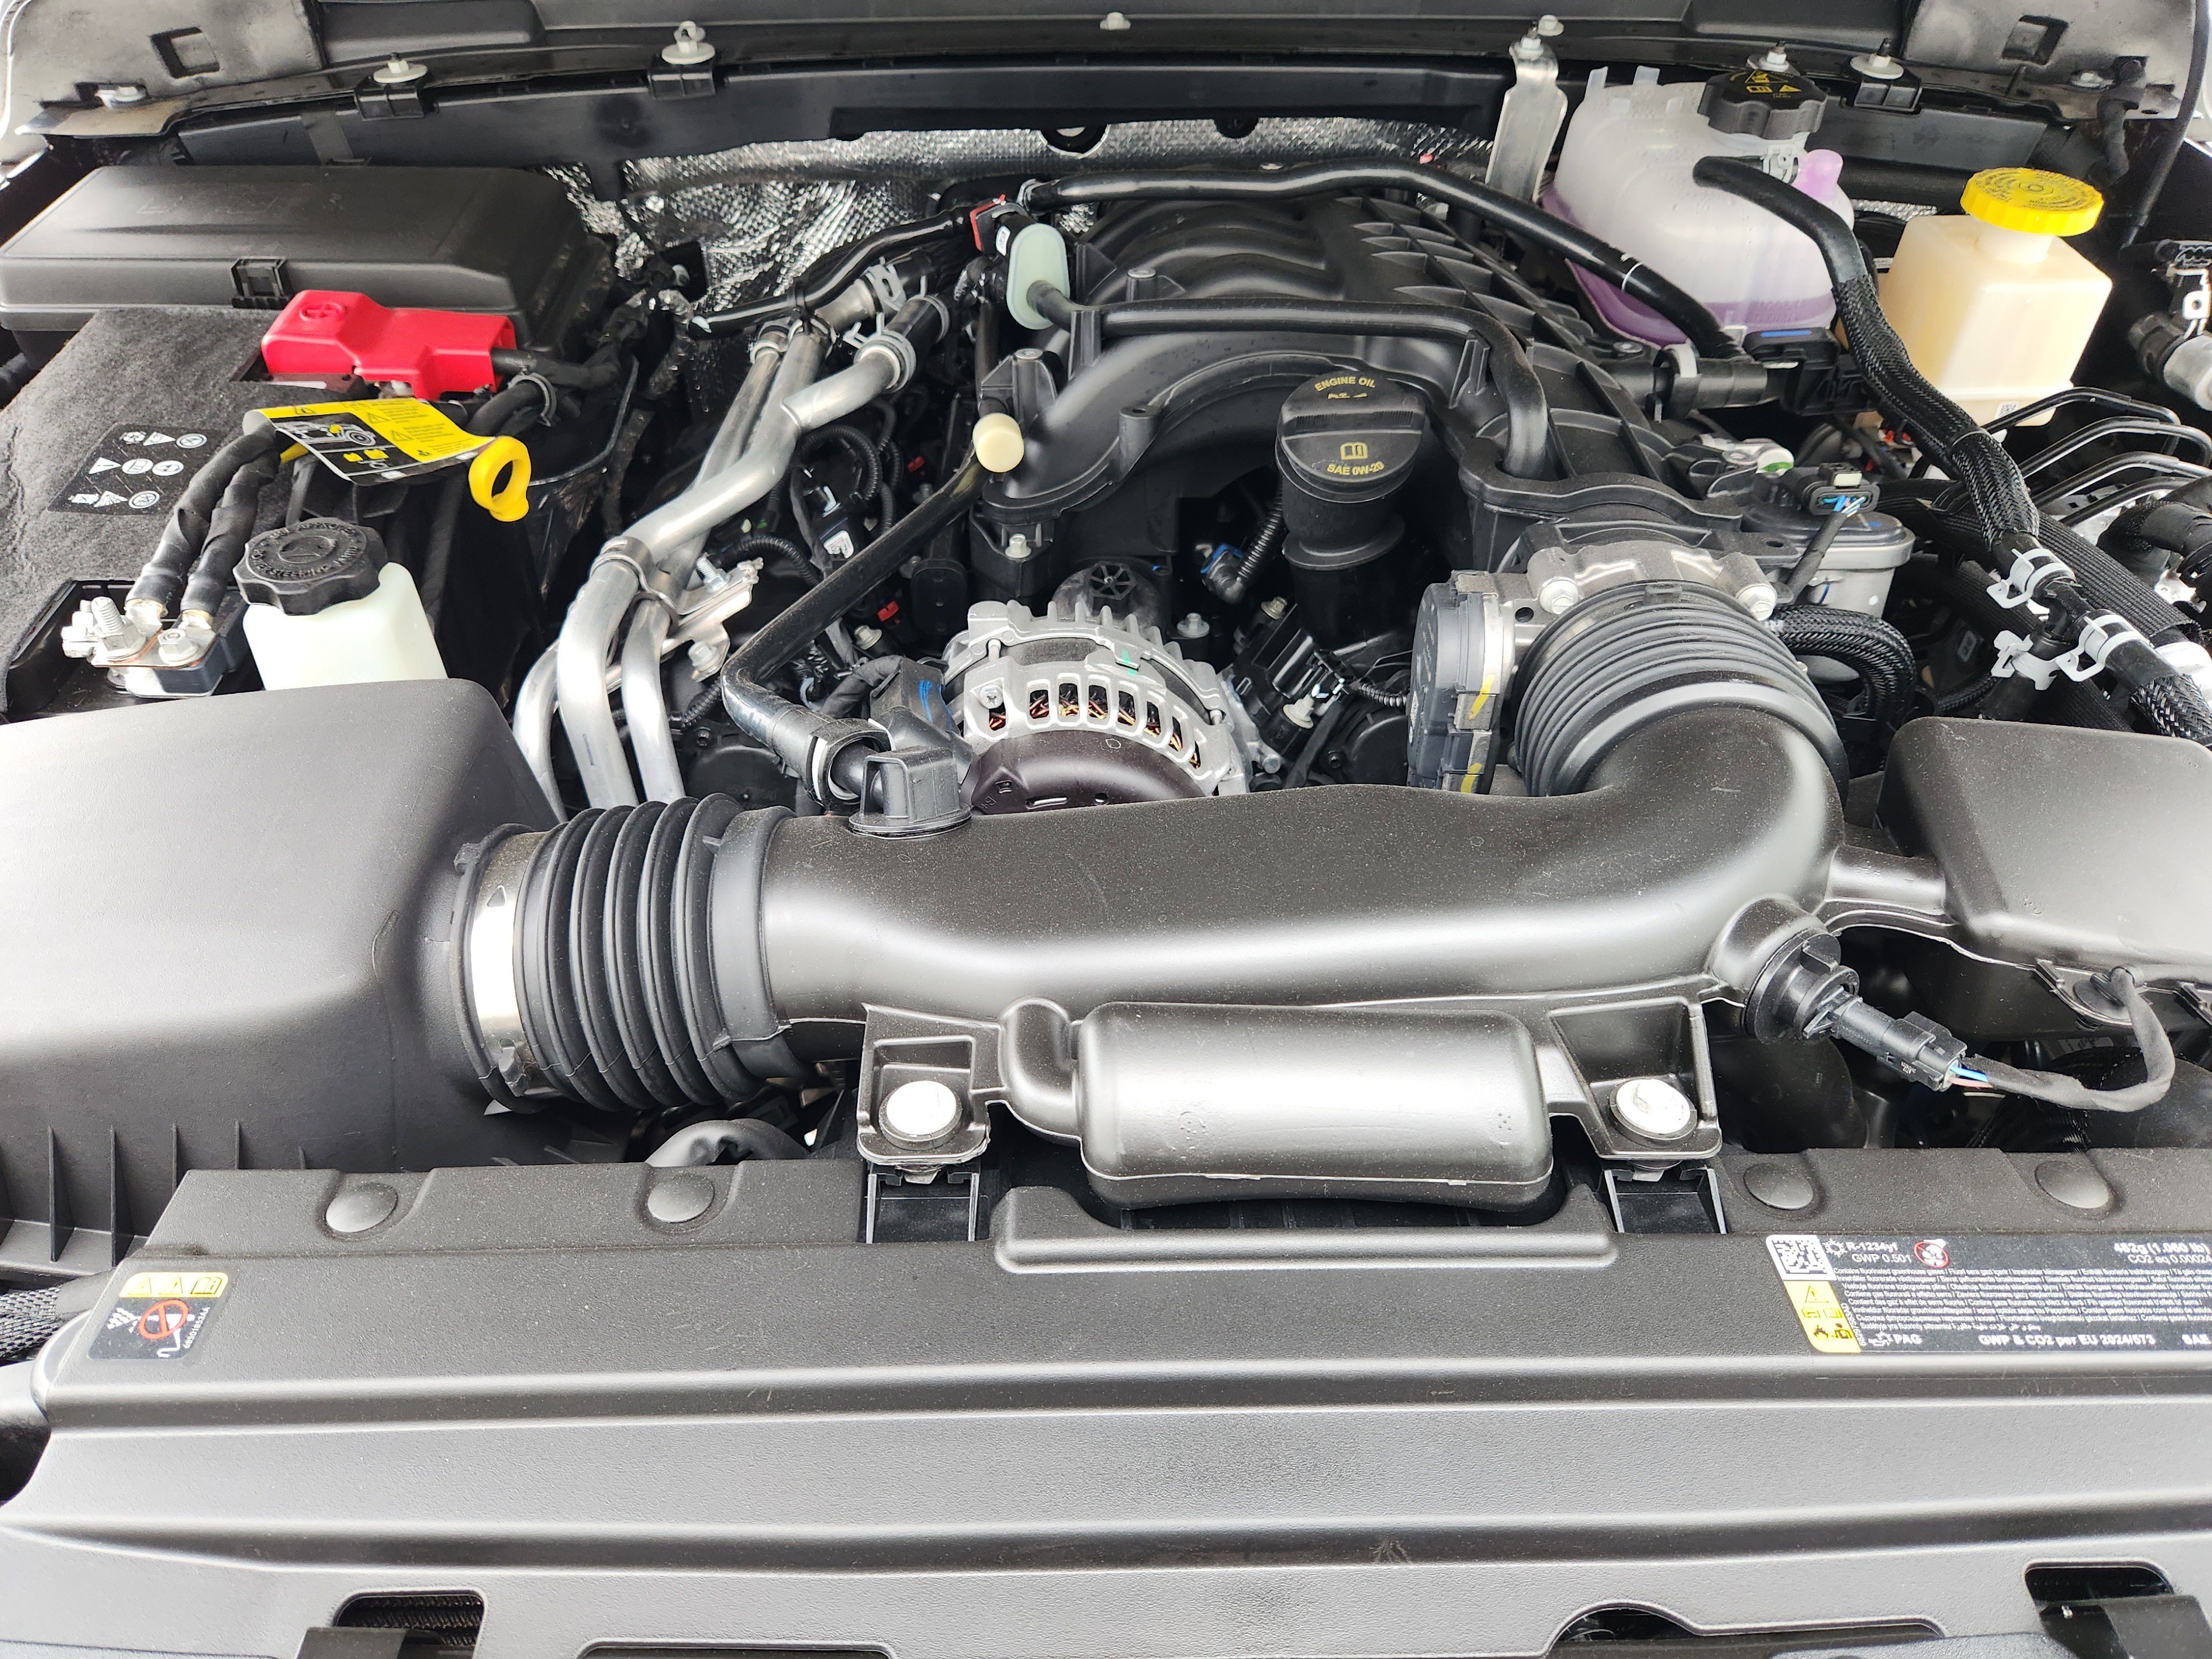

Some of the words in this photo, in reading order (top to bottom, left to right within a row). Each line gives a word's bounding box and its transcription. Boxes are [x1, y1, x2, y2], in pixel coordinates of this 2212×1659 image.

[1314, 376, 1356, 392] ENGINE
[1358, 377, 1376, 388] OIL
[1327, 463, 1350, 476] SAE
[1352, 461, 1384, 476] 0W-20
[1845, 1241, 1898, 1253] R-1234yf
[1852, 1254, 1880, 1263] GWP
[1882, 1254, 1912, 1263] 0.501
[2128, 1255, 2154, 1264] CO2
[2155, 1256, 2171, 1265] eq
[1893, 1334, 1923, 1345] PAG
[1978, 1334, 2011, 1345] GWP
[2025, 1334, 2054, 1345] CO2
[2055, 1336, 2077, 1348] per
[2078, 1334, 2099, 1345] EU
[2100, 1334, 2156, 1345] 2024/573
[2182, 1334, 2212, 1345] SAE
